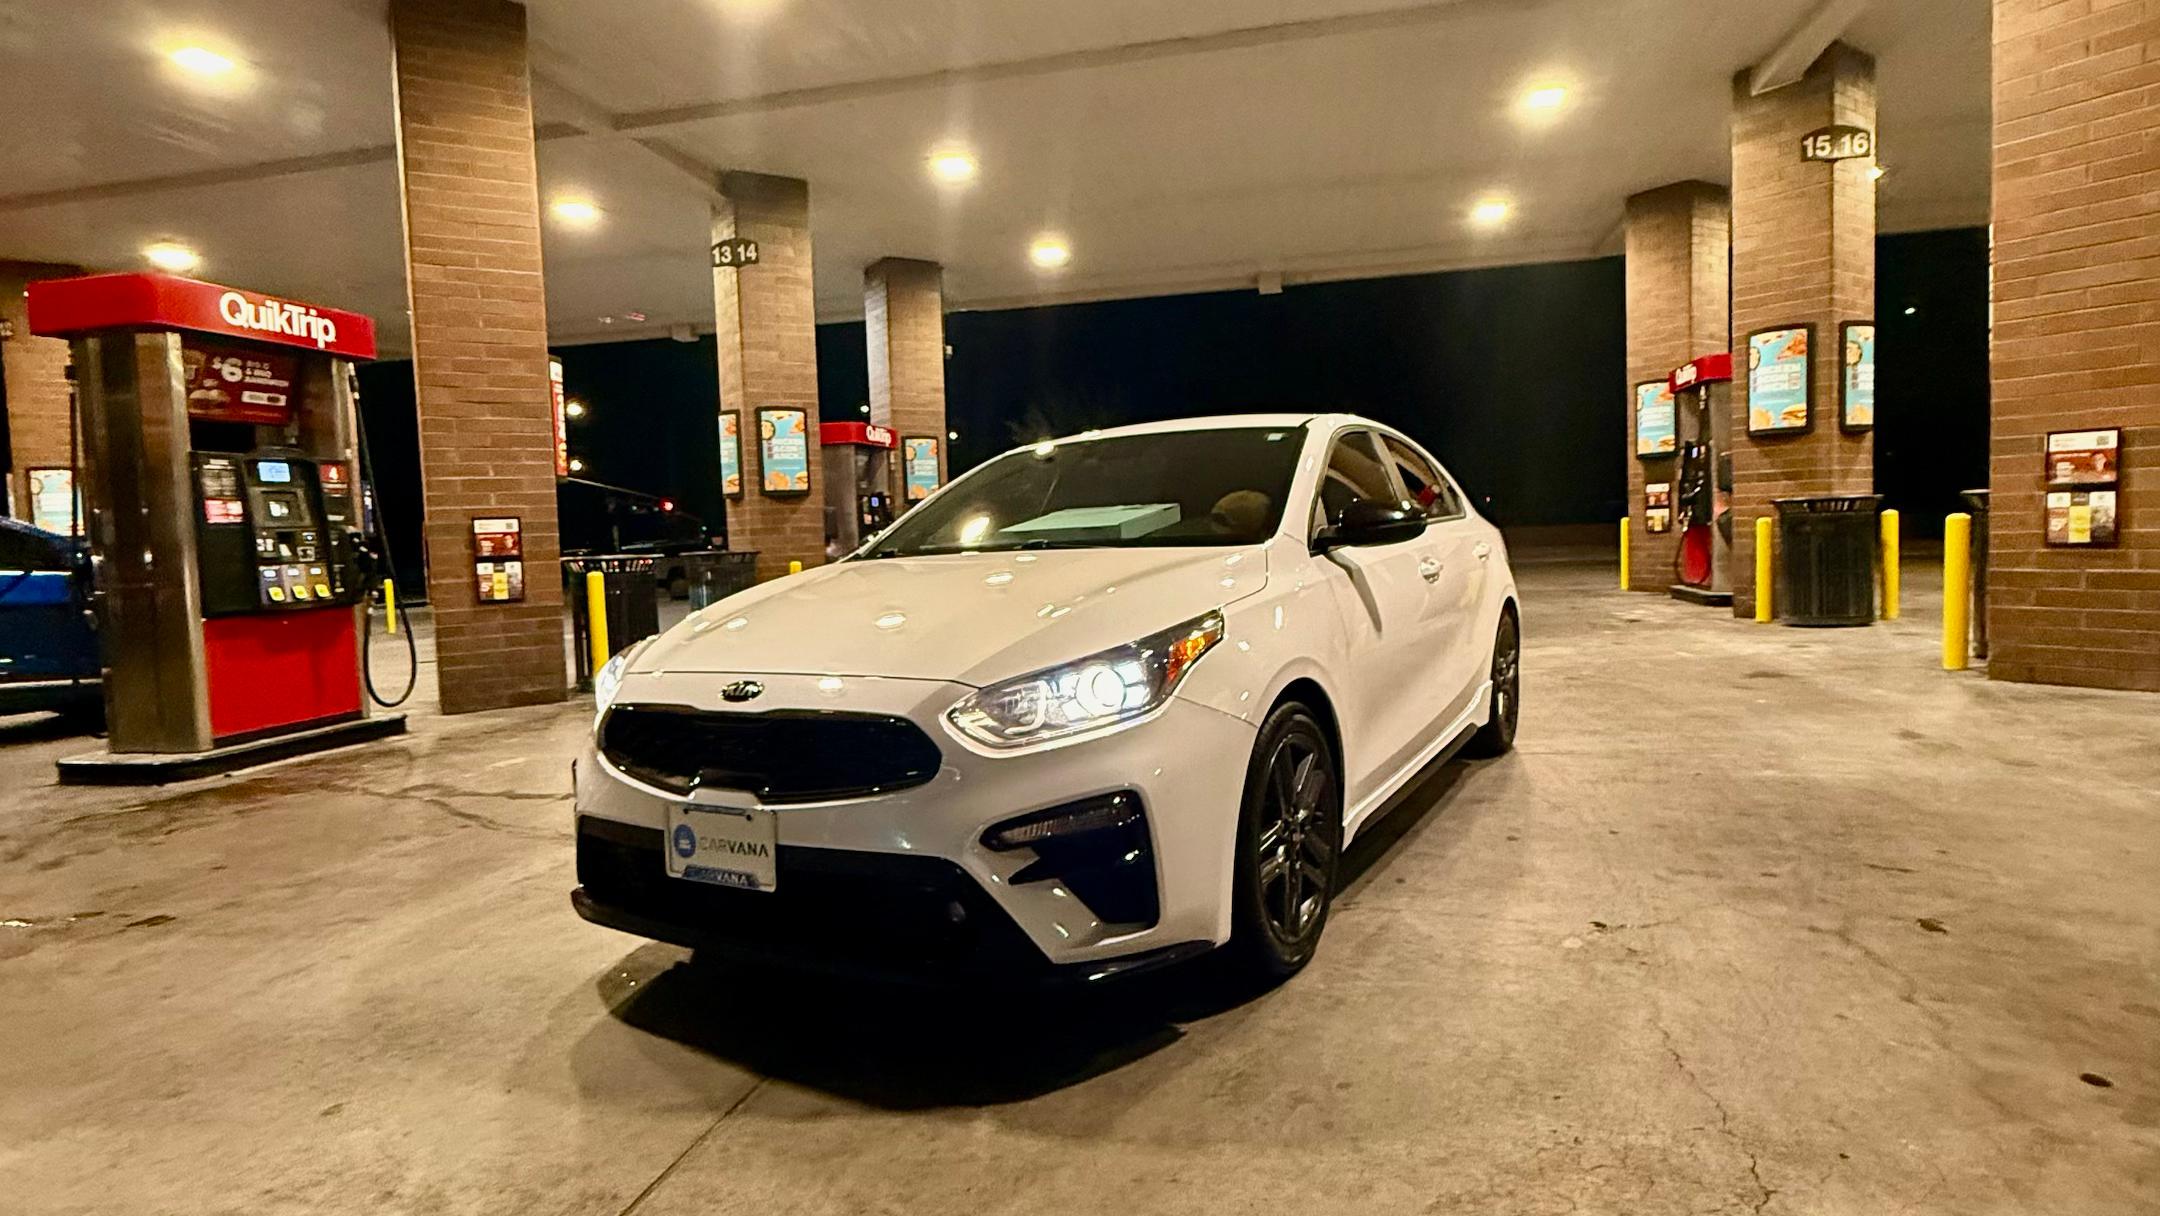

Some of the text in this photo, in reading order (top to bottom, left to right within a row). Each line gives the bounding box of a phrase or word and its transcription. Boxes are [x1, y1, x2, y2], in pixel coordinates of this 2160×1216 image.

[1802, 135, 1832, 157] 15
[1841, 132, 1868, 154] 16
[711, 246, 732, 264] 13
[737, 243, 757, 262] 14
[219, 291, 337, 348] QuikTrip
[700, 836, 769, 857] CARVANA
